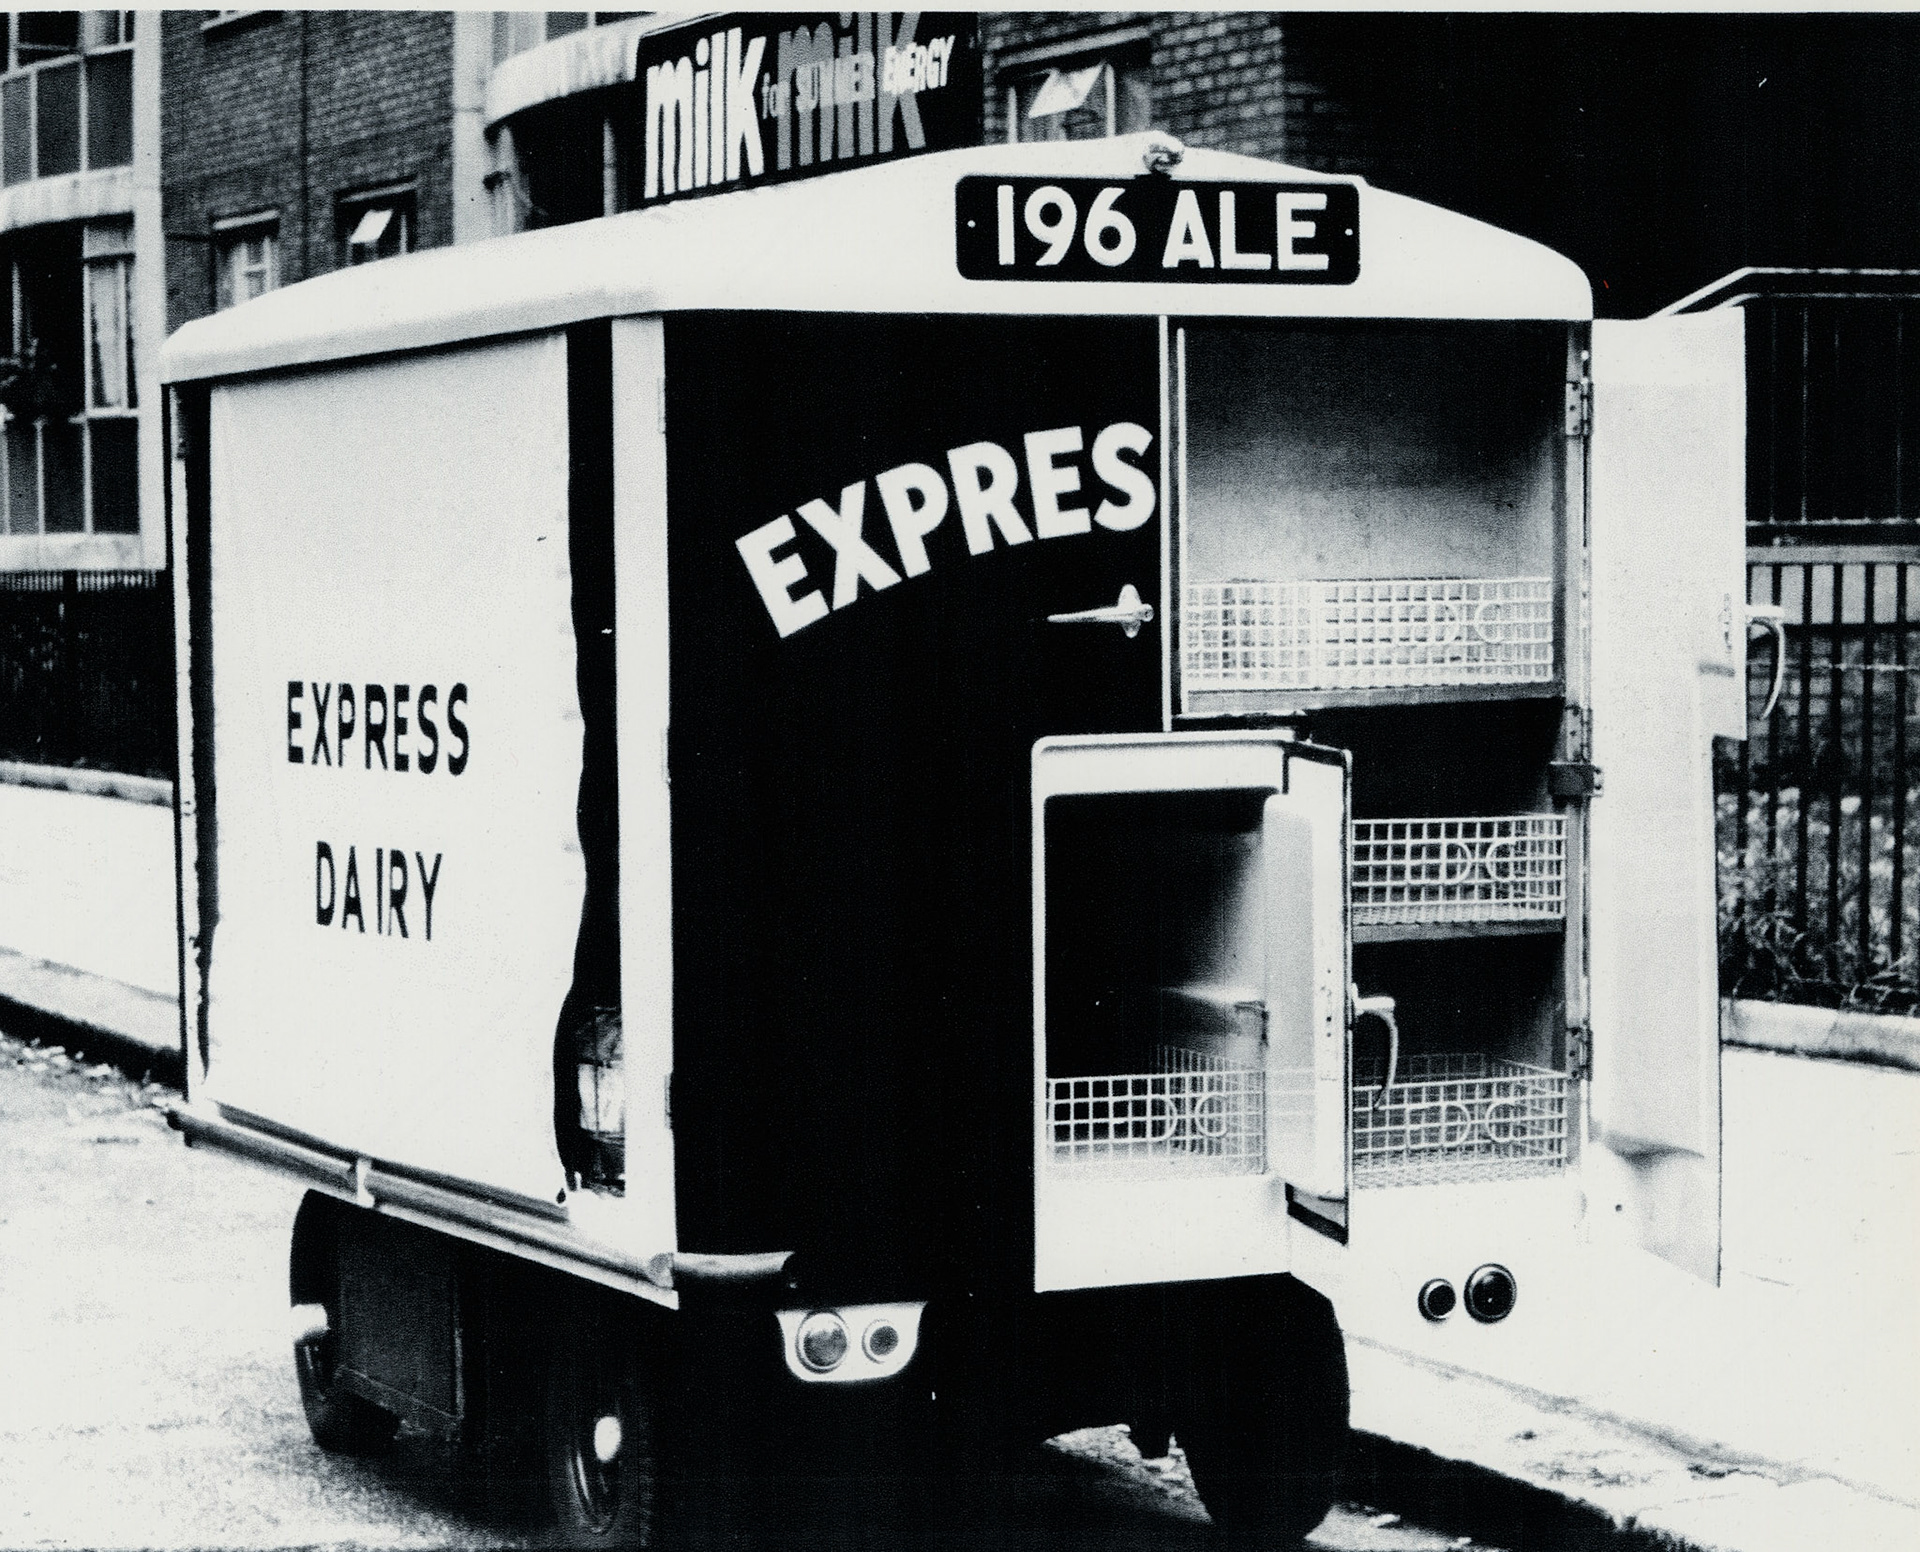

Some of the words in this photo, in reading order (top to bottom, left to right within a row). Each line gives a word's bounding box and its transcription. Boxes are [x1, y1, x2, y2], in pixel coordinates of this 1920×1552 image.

[644, 27, 767, 199] milk
[998, 184, 1137, 267] 196
[1162, 189, 1330, 270] ALE
[735, 421, 1157, 639] EXPRES
[287, 681, 469, 777] EXPRESS
[315, 840, 443, 942] DAIRY
